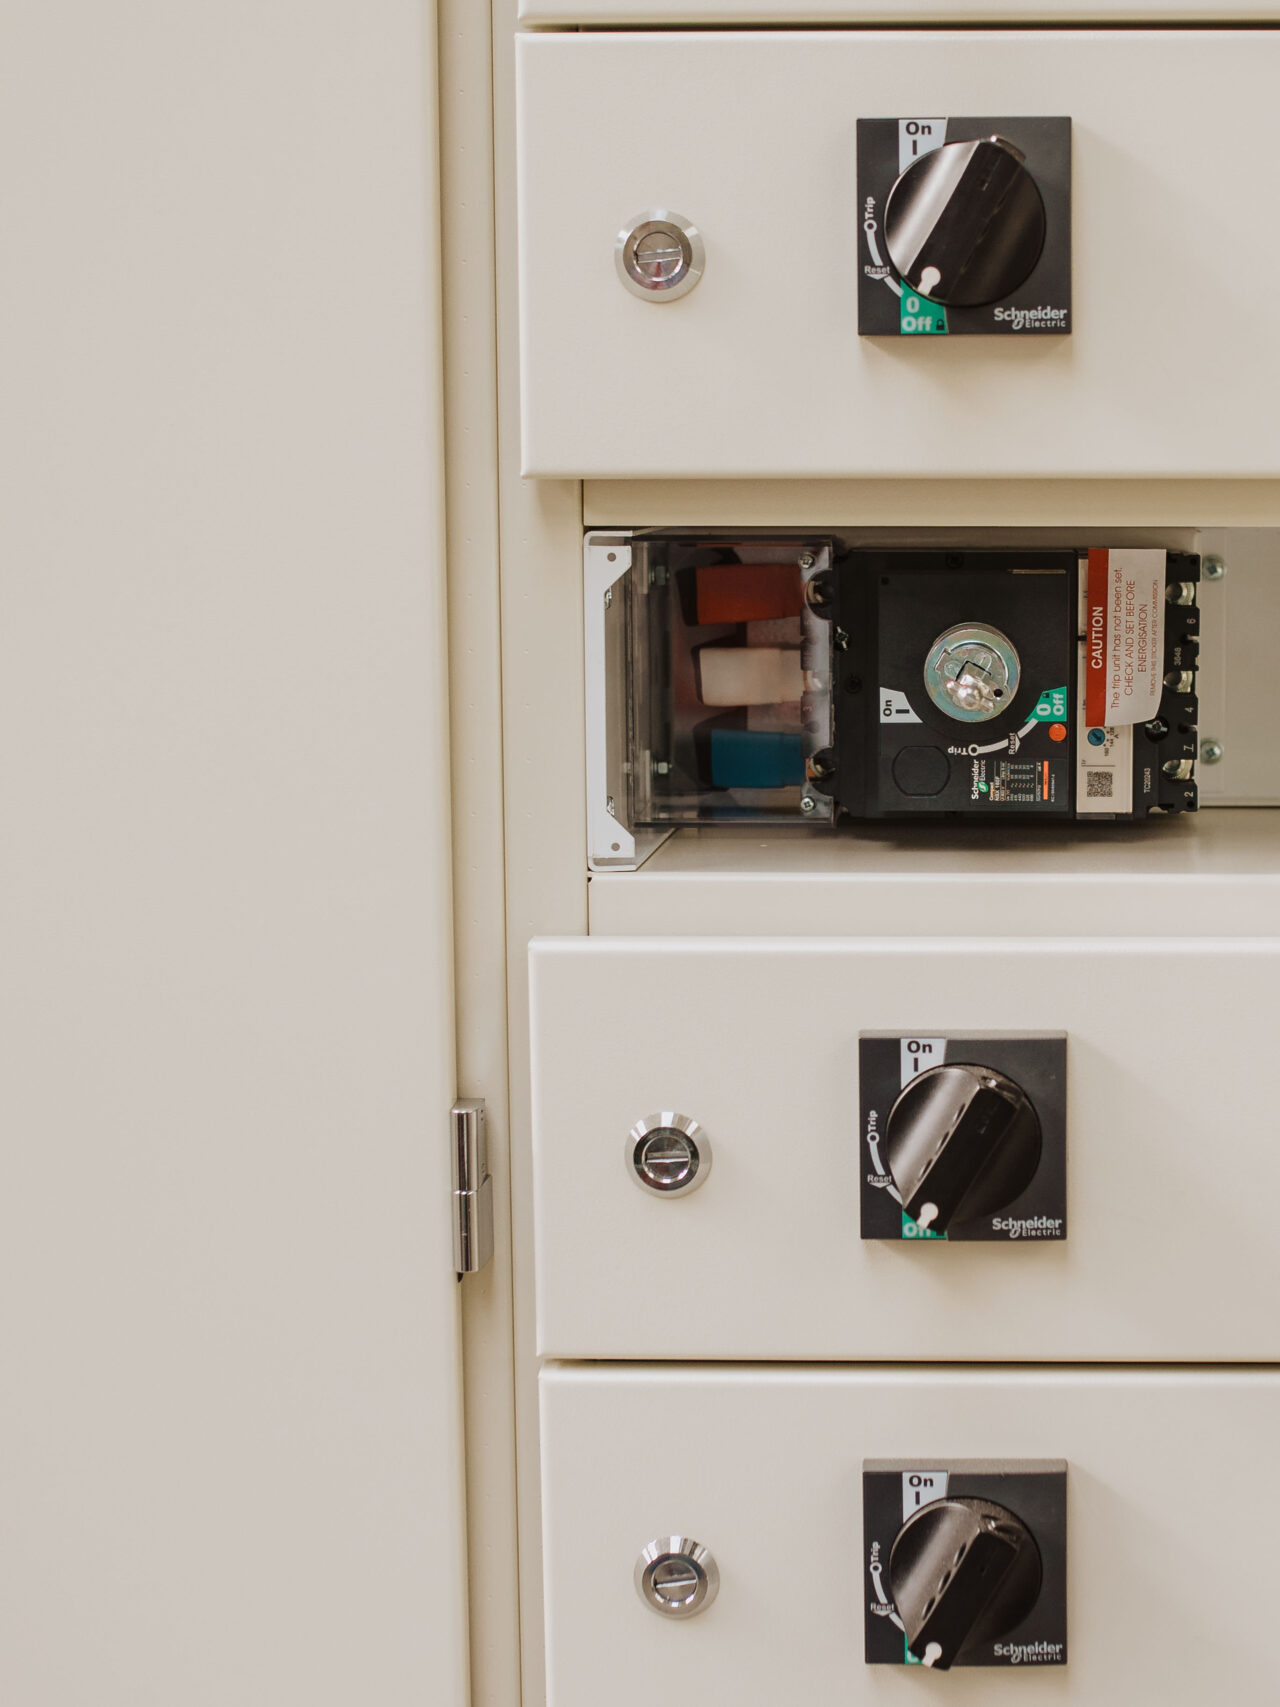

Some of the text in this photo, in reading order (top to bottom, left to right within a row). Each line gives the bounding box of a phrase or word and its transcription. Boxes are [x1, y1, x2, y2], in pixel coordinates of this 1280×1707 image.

[906, 122, 932, 135] On
[865, 197, 875, 219] Trip
[865, 266, 890, 274] Reset
[994, 306, 1067, 321] Schneider
[902, 317, 932, 331] Off
[1113, 587, 1122, 612] been
[1113, 615, 1122, 631] not
[1091, 607, 1103, 669] CAUTION
[1113, 634, 1121, 651] has
[1125, 580, 1135, 696] CHECK AND SET BEFORE
[1138, 604, 1147, 672] ENERGISATION
[1112, 654, 1121, 671] unit
[1112, 675, 1121, 689] trip
[1053, 693, 1065, 715] Off
[1111, 692, 1120, 708] The
[883, 700, 892, 717] On
[948, 746, 968, 755] Trip
[971, 759, 979, 799] Schneider
[907, 1040, 932, 1053] On
[868, 1110, 878, 1131] Trip
[992, 1216, 1062, 1230] Schneider
[1022, 1228, 1060, 1236] Electric
[909, 1475, 934, 1487] On
[871, 1541, 880, 1562] Trip
[870, 1603, 894, 1611] Reset
[994, 1642, 1062, 1656] Schneider
